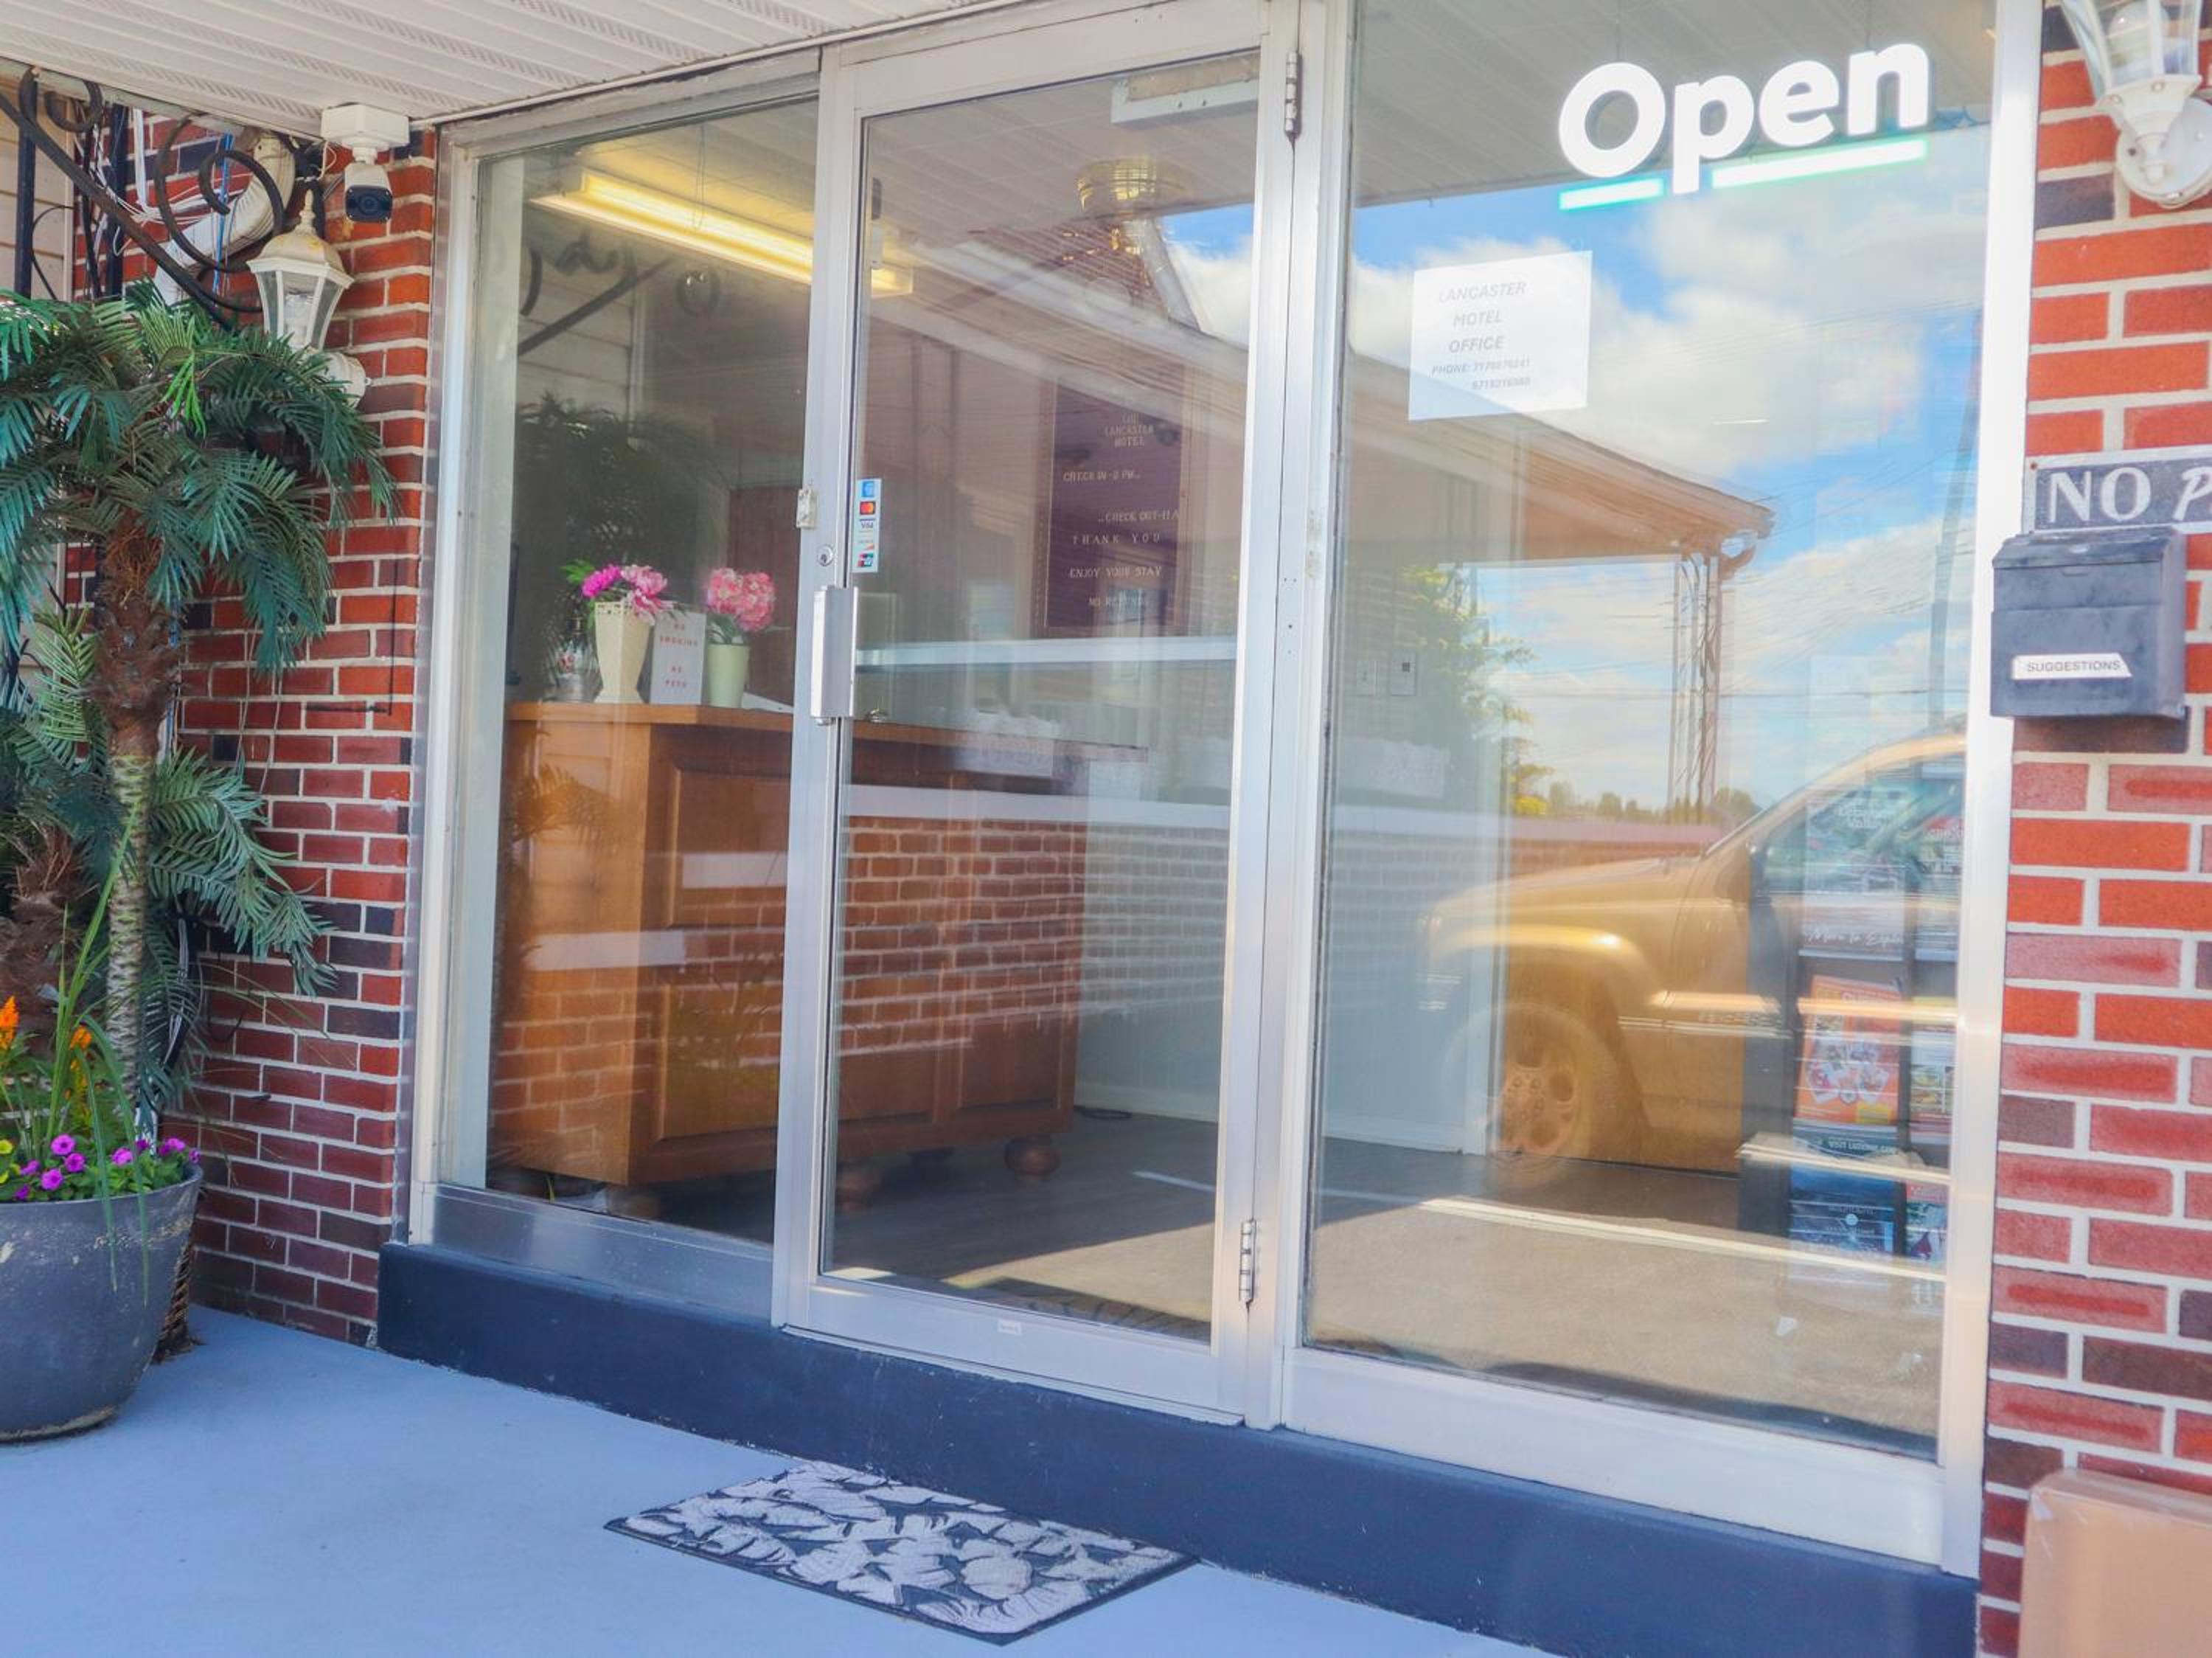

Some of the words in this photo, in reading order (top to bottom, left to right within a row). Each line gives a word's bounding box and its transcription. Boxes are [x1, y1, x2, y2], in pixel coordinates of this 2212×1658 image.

[1558, 43, 1930, 194] Open
[1439, 281, 1527, 303] LANCASTER
[1453, 310, 1504, 327] MOTEL
[1448, 336, 1505, 354] OFFICE
[2048, 467, 2152, 523] NO
[2172, 465, 2212, 521] P
[1073, 533, 1120, 546] THANK
[1131, 532, 1161, 544] YOU
[1069, 566, 1099, 578] ENJOY
[1134, 566, 1162, 577] STAY
[2027, 660, 2121, 672] SUGGESTIONS
